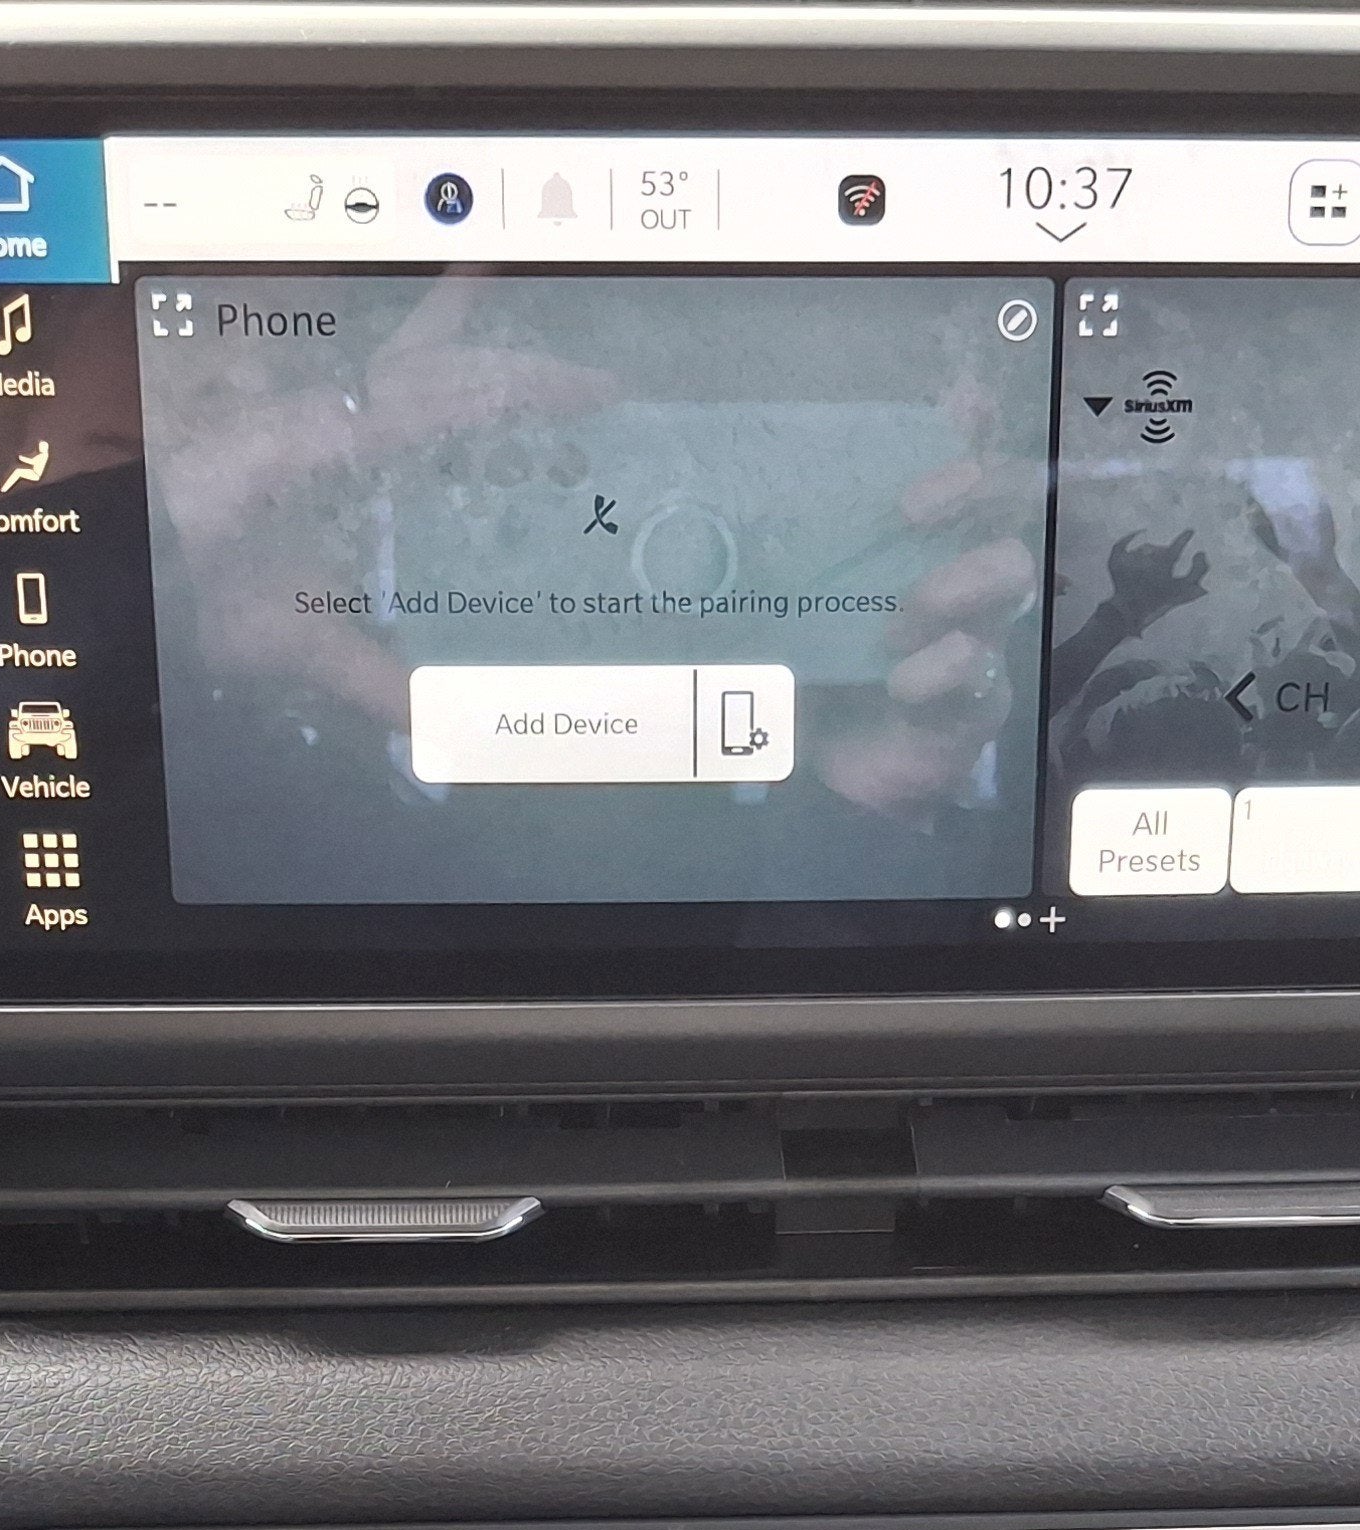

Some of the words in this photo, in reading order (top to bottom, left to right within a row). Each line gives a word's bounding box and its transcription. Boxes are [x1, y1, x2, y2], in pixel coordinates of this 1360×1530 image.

[639, 170, 690, 199] 53°
[998, 166, 1134, 210] 10:37
[640, 209, 693, 231] OUT
[217, 303, 337, 337] Phone
[294, 590, 372, 615] Select
[549, 592, 576, 614] to
[582, 592, 643, 614] start
[651, 589, 693, 614] the
[699, 589, 789, 619] pairing
[796, 592, 905, 619] process.
[1276, 682, 1330, 712] CH
[495, 713, 545, 736] Add
[553, 713, 639, 736] Device
[0, 775, 91, 799] Vehicle
[1243, 799, 1252, 820] 1
[1131, 810, 1168, 837] All
[1098, 847, 1202, 874] Presets
[23, 903, 89, 931] Apps
